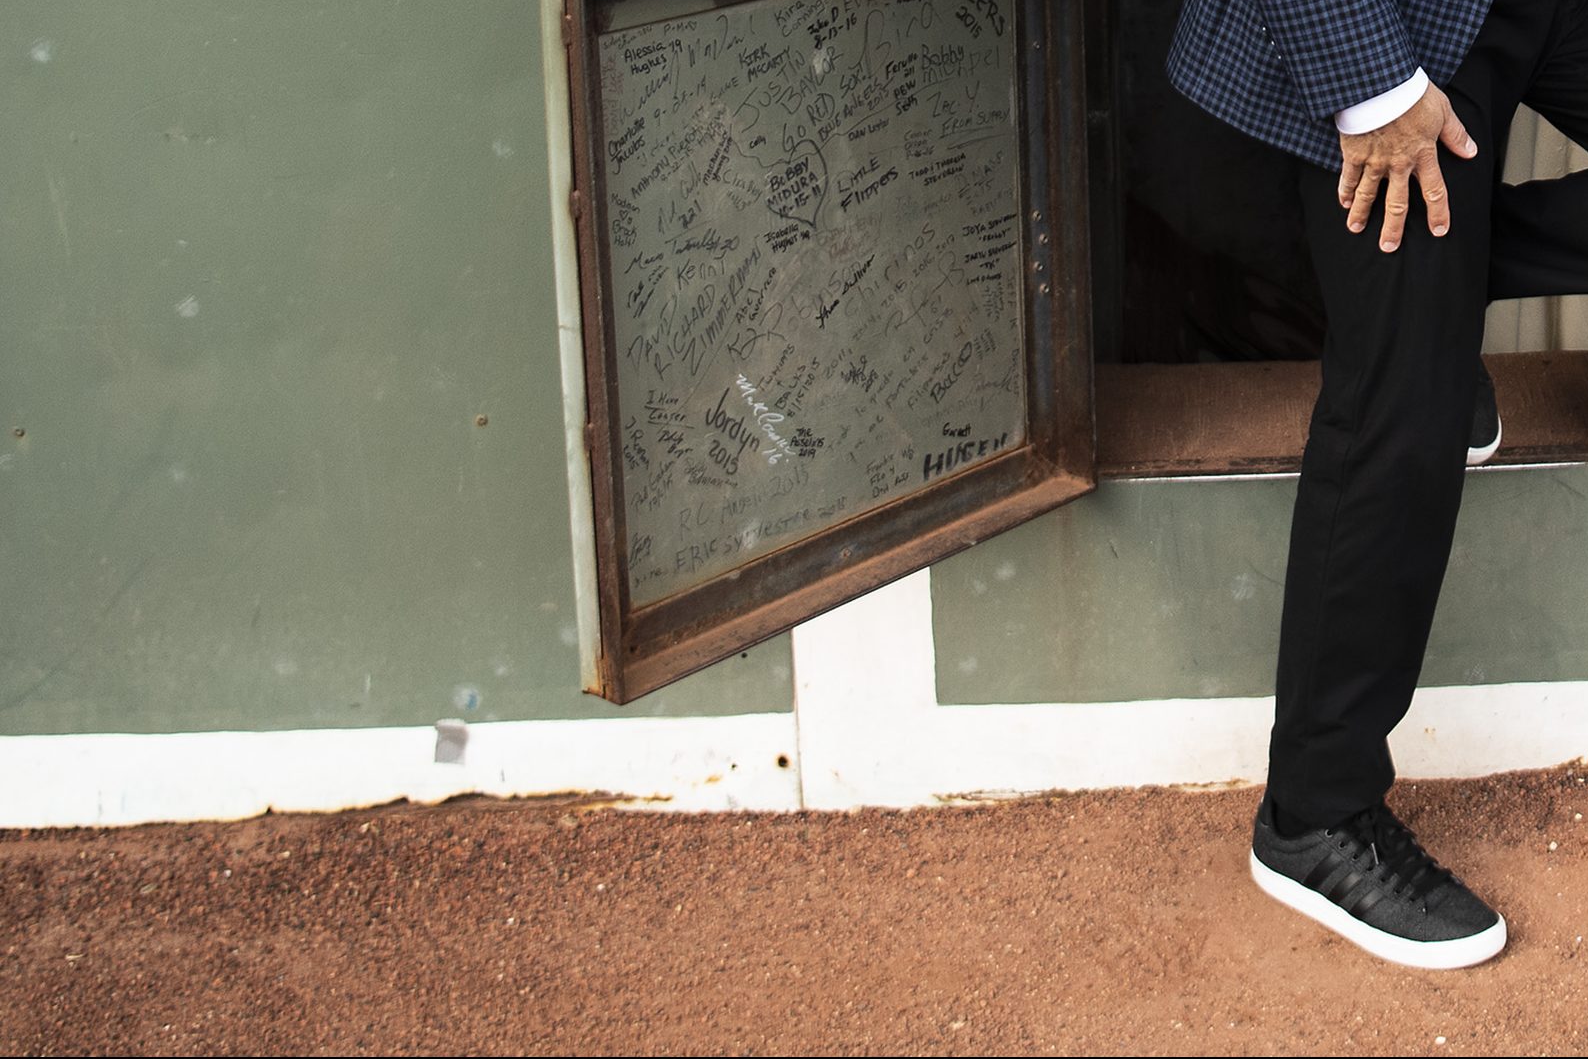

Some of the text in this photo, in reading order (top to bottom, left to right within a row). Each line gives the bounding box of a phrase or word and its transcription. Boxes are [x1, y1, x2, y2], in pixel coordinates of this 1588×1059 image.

[630, 55, 669, 76] Hughes
[920, 42, 966, 71] Bobby
[704, 386, 761, 455] Jordyn
[708, 439, 739, 476] 2015
